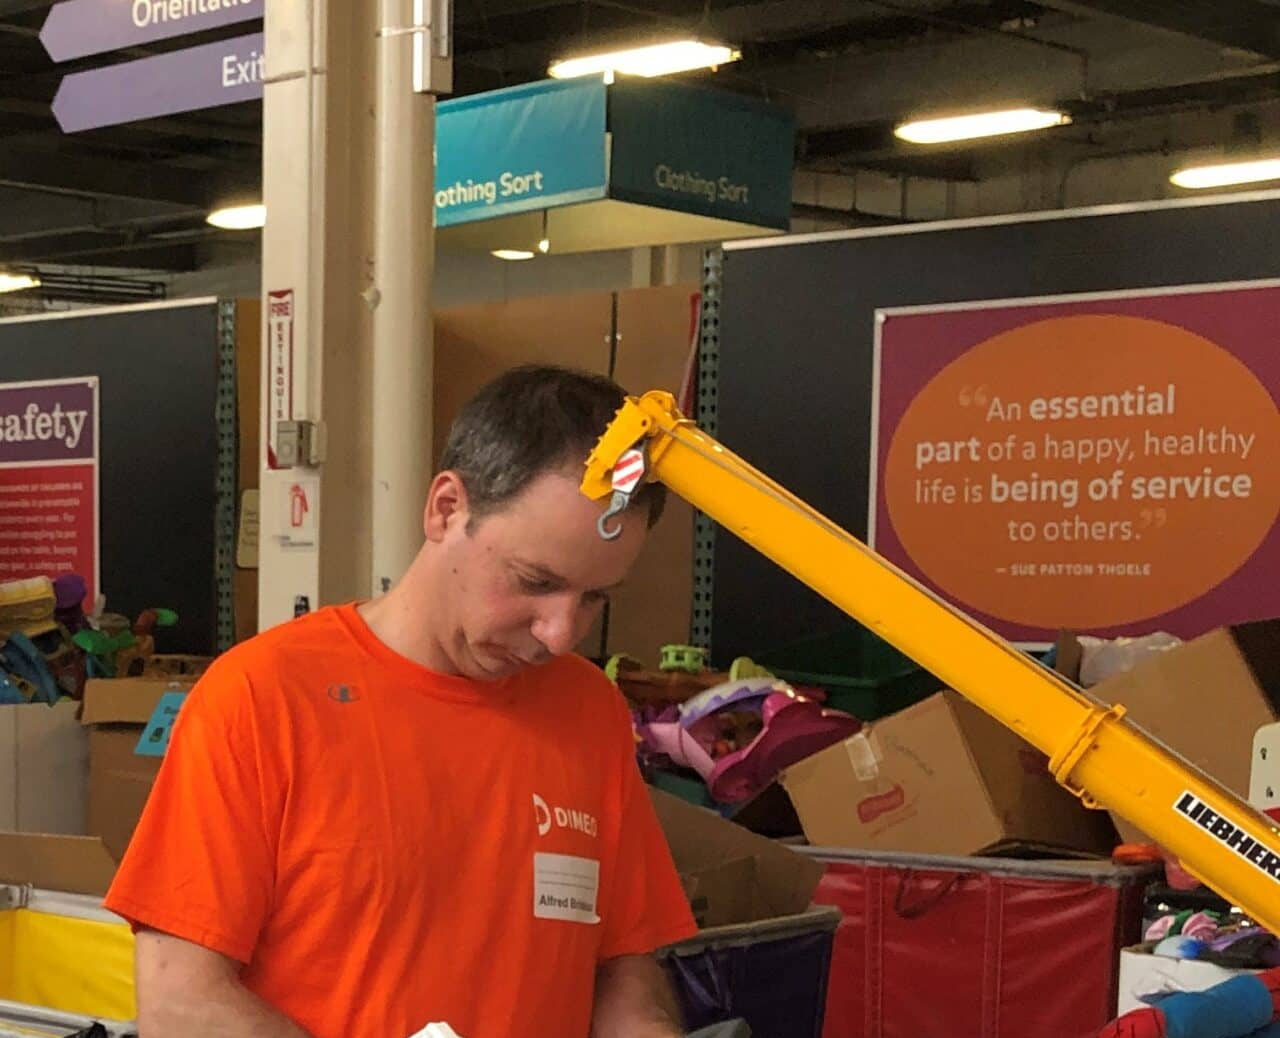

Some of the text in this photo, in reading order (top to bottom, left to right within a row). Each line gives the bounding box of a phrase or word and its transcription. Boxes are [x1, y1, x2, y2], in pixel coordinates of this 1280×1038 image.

[132, 0, 251, 27] Orient
[222, 52, 264, 87] Exit
[435, 170, 543, 207] othing Sort
[655, 164, 749, 203] Clothing Sort
[1029, 384, 1175, 421] essential
[916, 426, 1255, 469] part of a happy, healthy
[916, 467, 1252, 508] life is being of service
[1008, 520, 1035, 541] to
[1011, 563, 1036, 576] SUE
[1040, 563, 1093, 576] PATTON
[554, 807, 597, 838] DIMEO
[1176, 793, 1280, 882] LIEBHER
